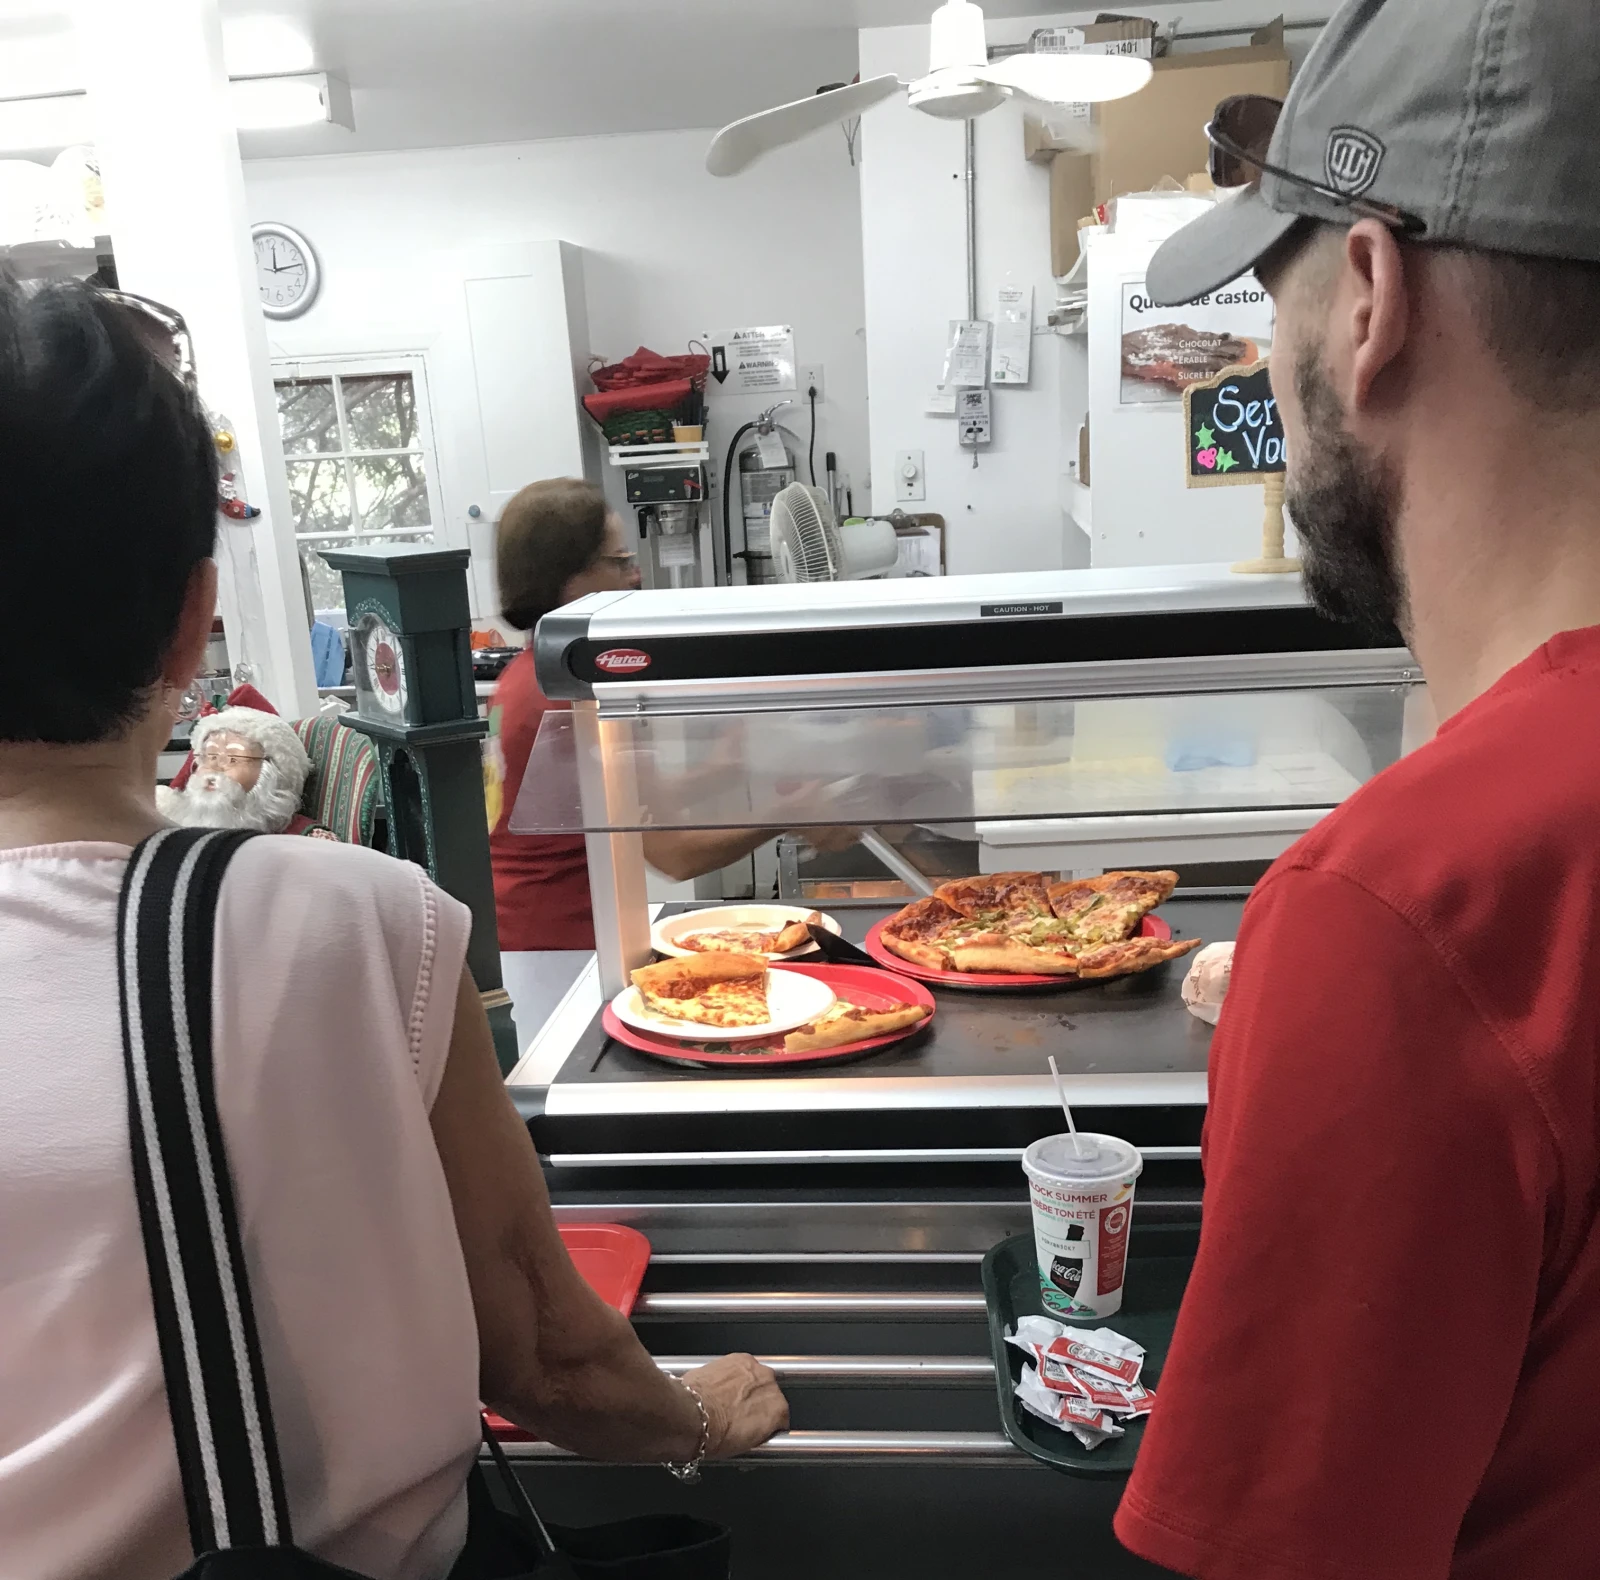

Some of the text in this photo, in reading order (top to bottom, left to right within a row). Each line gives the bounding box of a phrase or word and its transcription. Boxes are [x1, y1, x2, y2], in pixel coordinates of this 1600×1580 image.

[290, 248, 297, 260] 2
[295, 277, 301, 288] 4
[276, 289, 283, 301] 6
[287, 285, 295, 297] 5
[1216, 289, 1267, 305] castor
[1179, 339, 1222, 348] CHOCOLAT
[1178, 371, 1204, 380] SUCRE
[1213, 385, 1277, 432] Ser
[993, 605, 1028, 613] CAUTION
[596, 654, 648, 668] Hatco
[1055, 1192, 1108, 1203] SUMMER
[1054, 1207, 1074, 1218] TON
[1076, 1209, 1096, 1219] ÉTÉ
